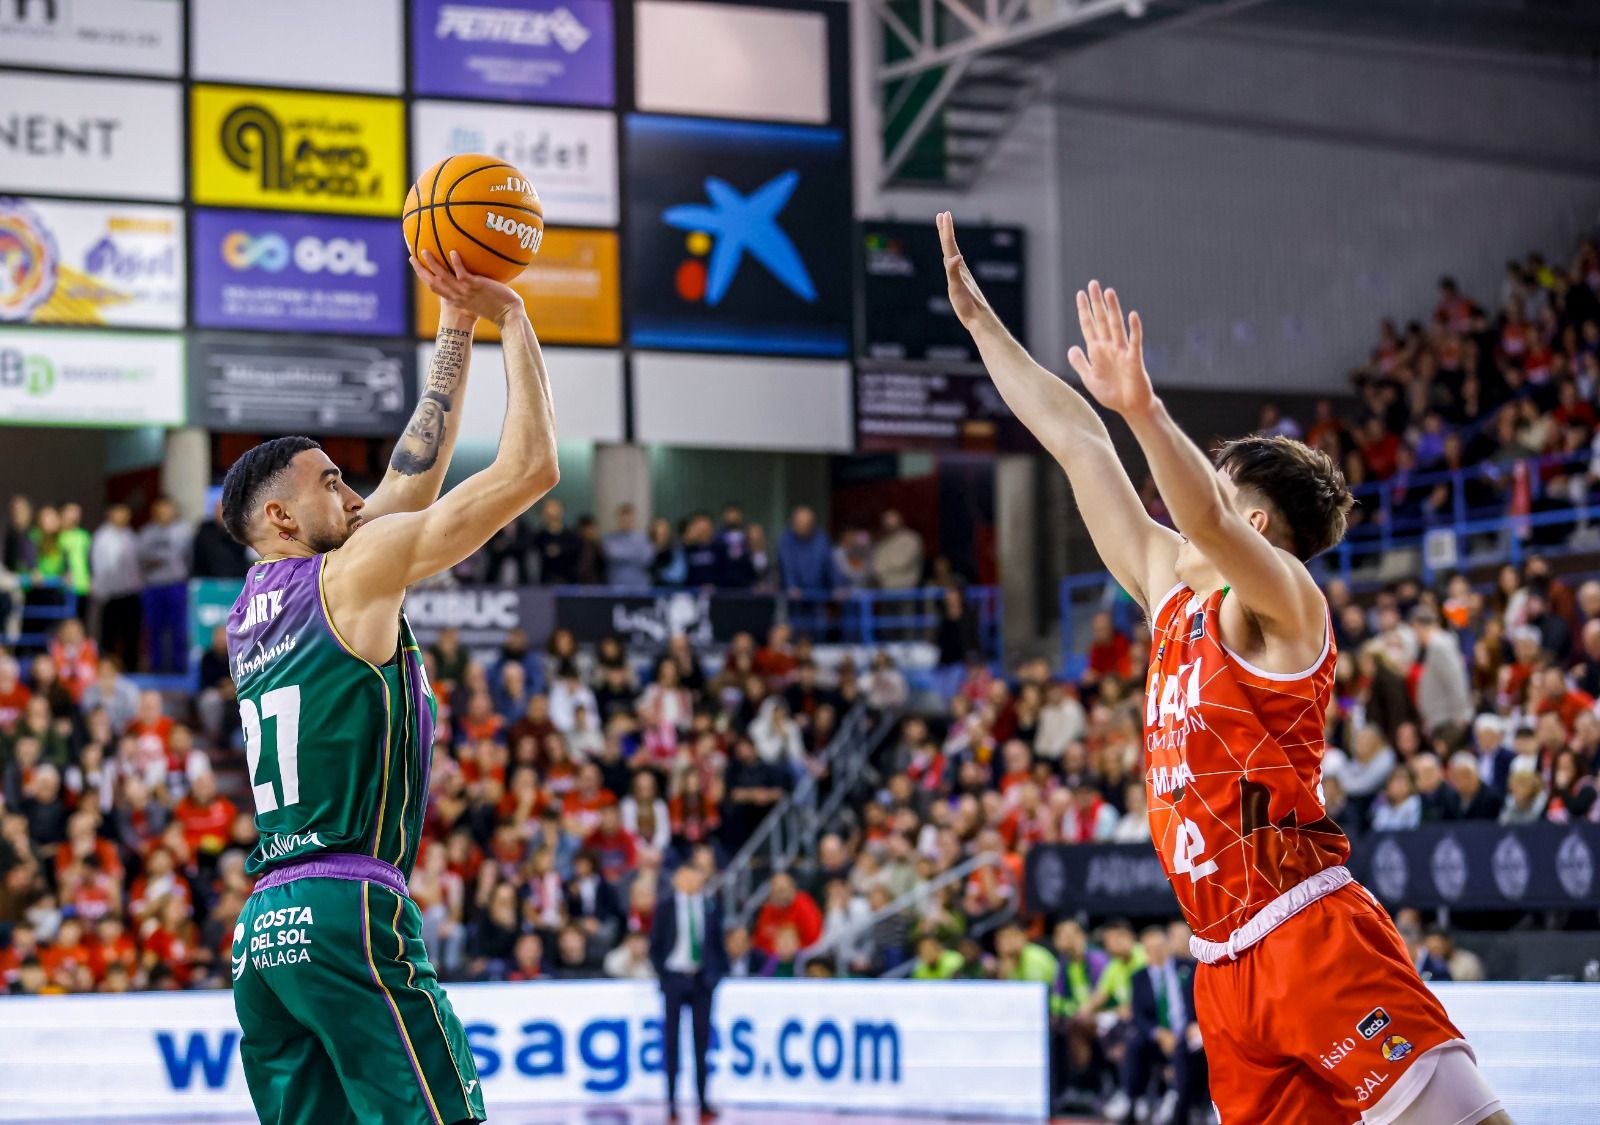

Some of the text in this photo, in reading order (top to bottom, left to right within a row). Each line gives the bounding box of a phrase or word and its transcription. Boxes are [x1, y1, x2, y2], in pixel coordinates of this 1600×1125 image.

[253, 906, 314, 933] COSTA
[250, 928, 312, 953] DEL SOL
[252, 948, 312, 971] MÁLAGA
[1364, 1018, 1384, 1037] acb
